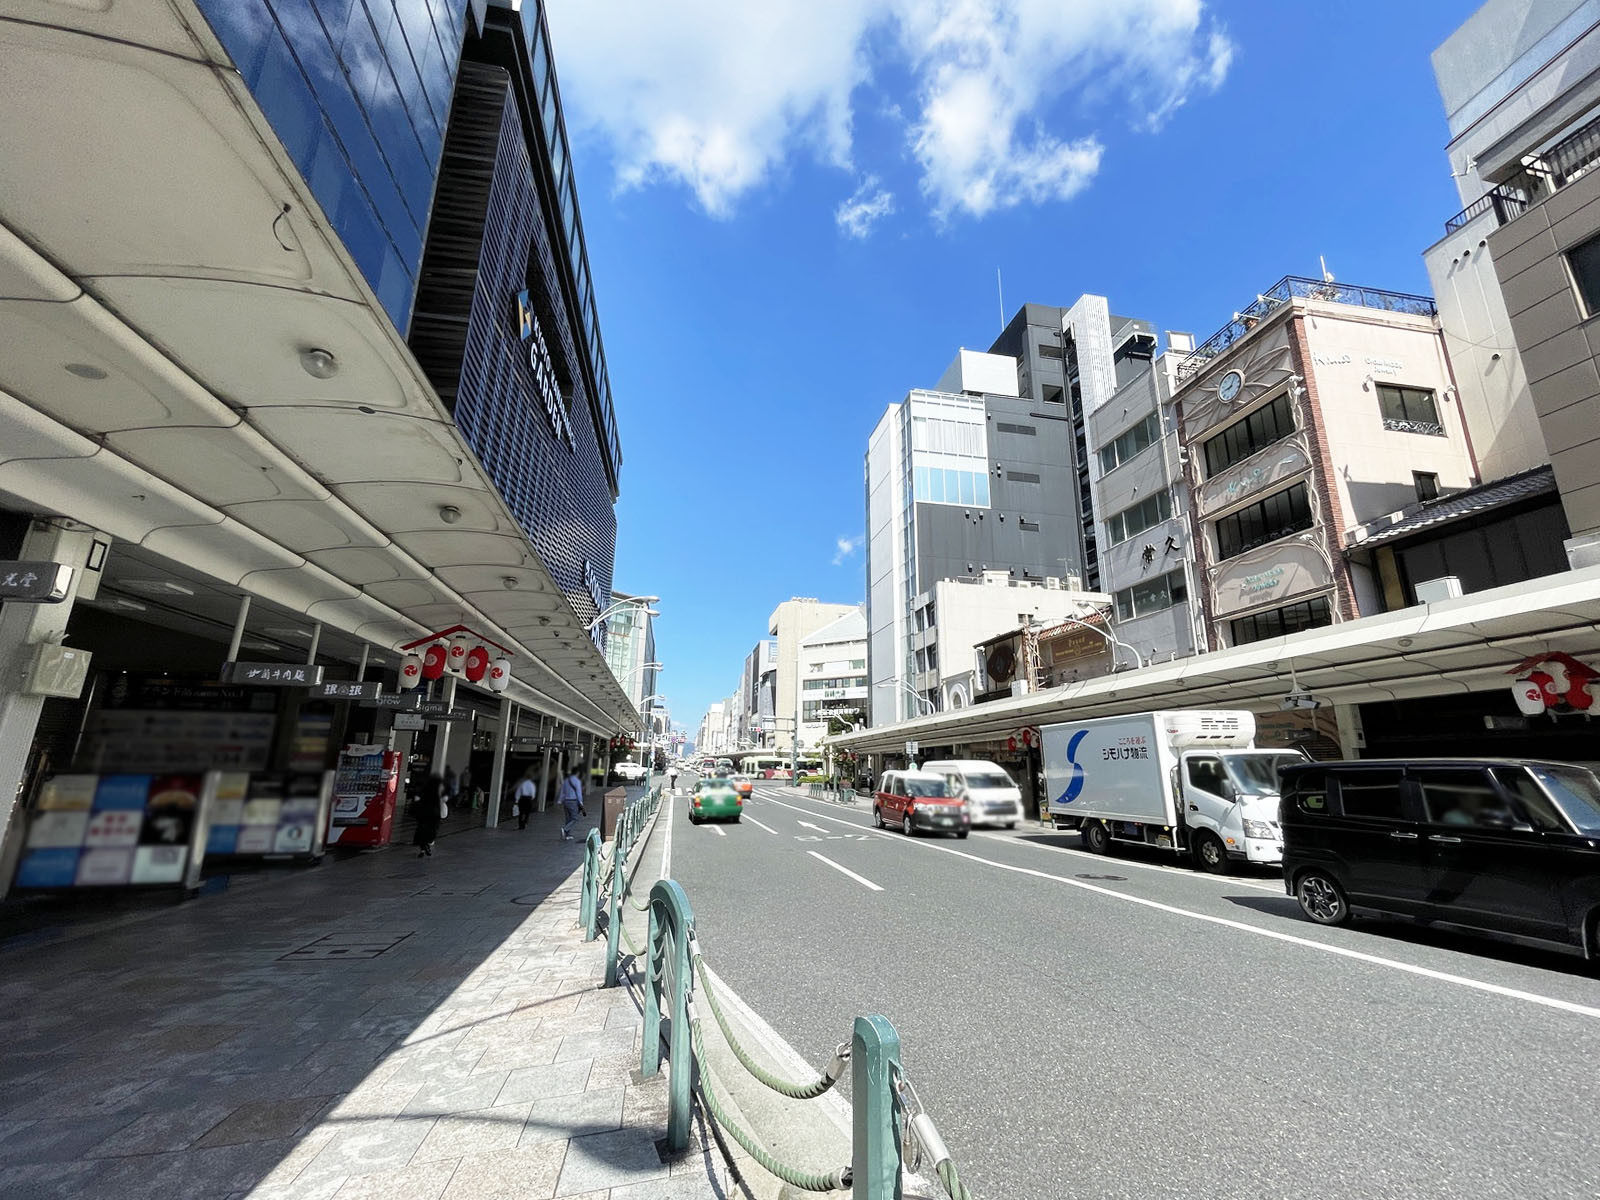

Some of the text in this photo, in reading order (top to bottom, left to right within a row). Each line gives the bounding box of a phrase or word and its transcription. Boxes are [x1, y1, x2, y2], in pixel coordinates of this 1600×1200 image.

[530, 342, 562, 440] GARDEN
[1102, 746, 1149, 760] シモハナ物流
